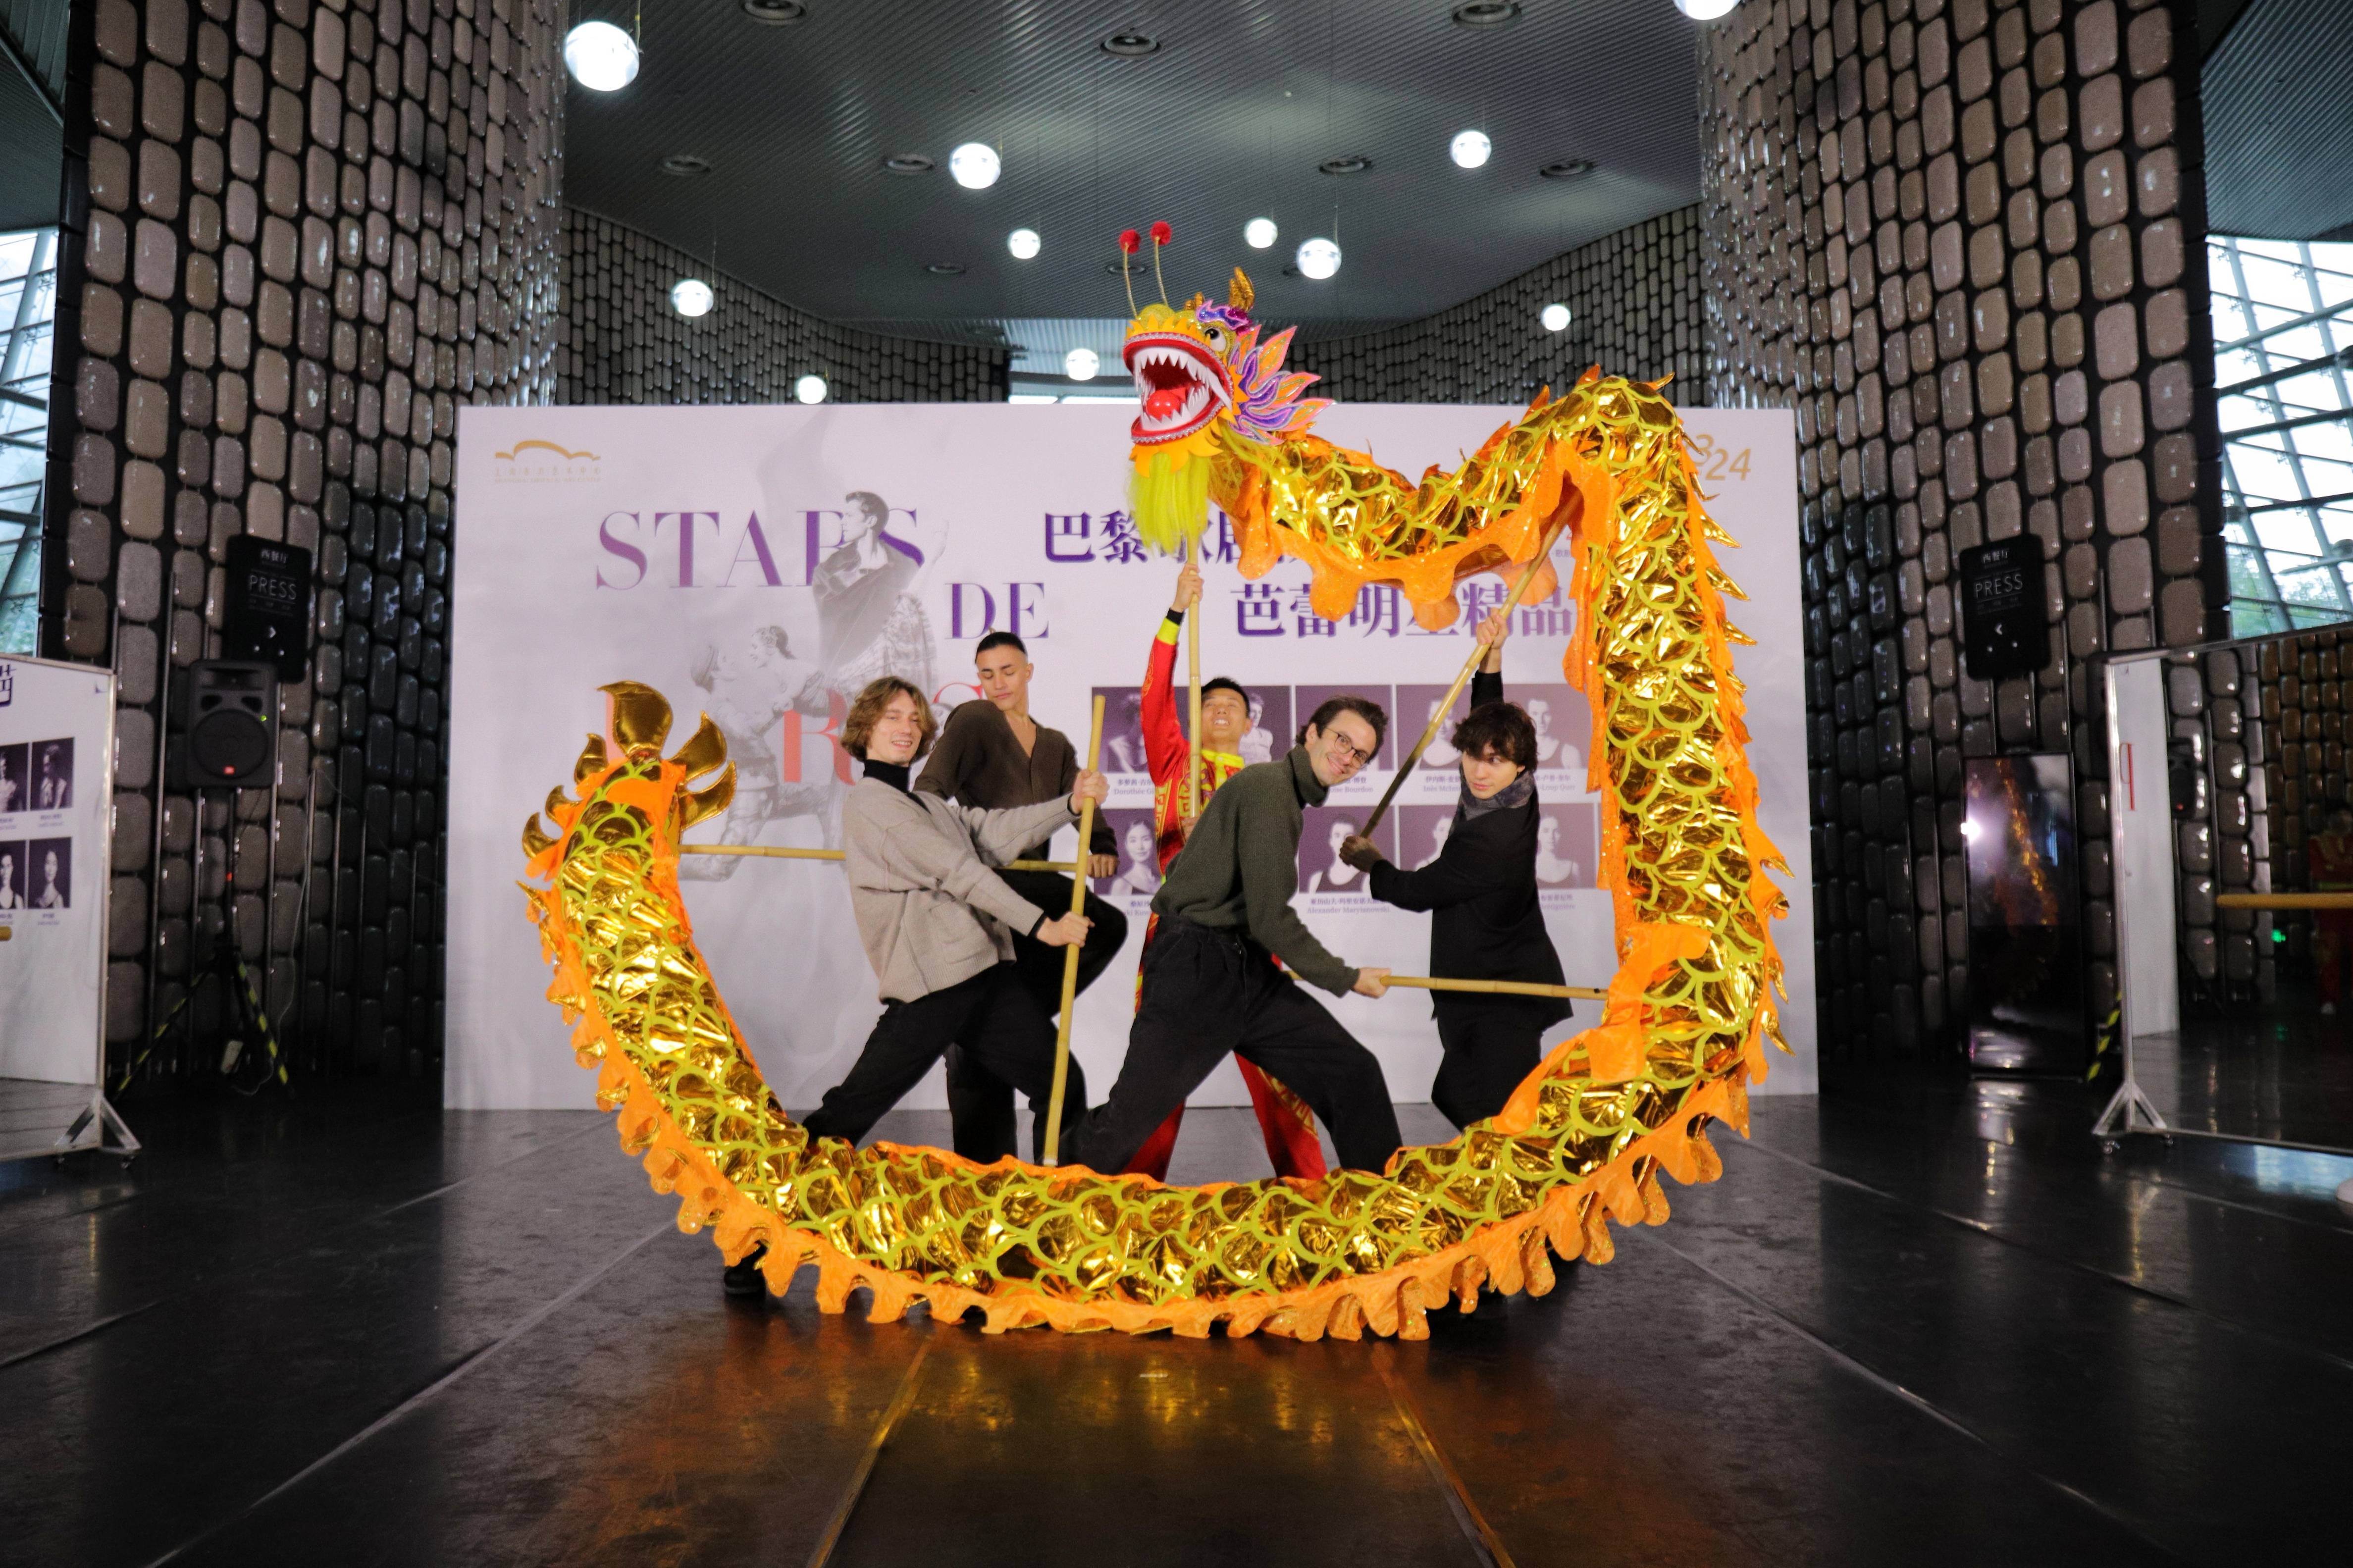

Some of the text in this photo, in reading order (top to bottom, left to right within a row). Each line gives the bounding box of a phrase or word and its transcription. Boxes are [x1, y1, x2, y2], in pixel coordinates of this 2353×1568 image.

[248, 575, 297, 600] PRESS
[1974, 573, 2023, 599] PRESS
[944, 582, 1048, 639] DE
